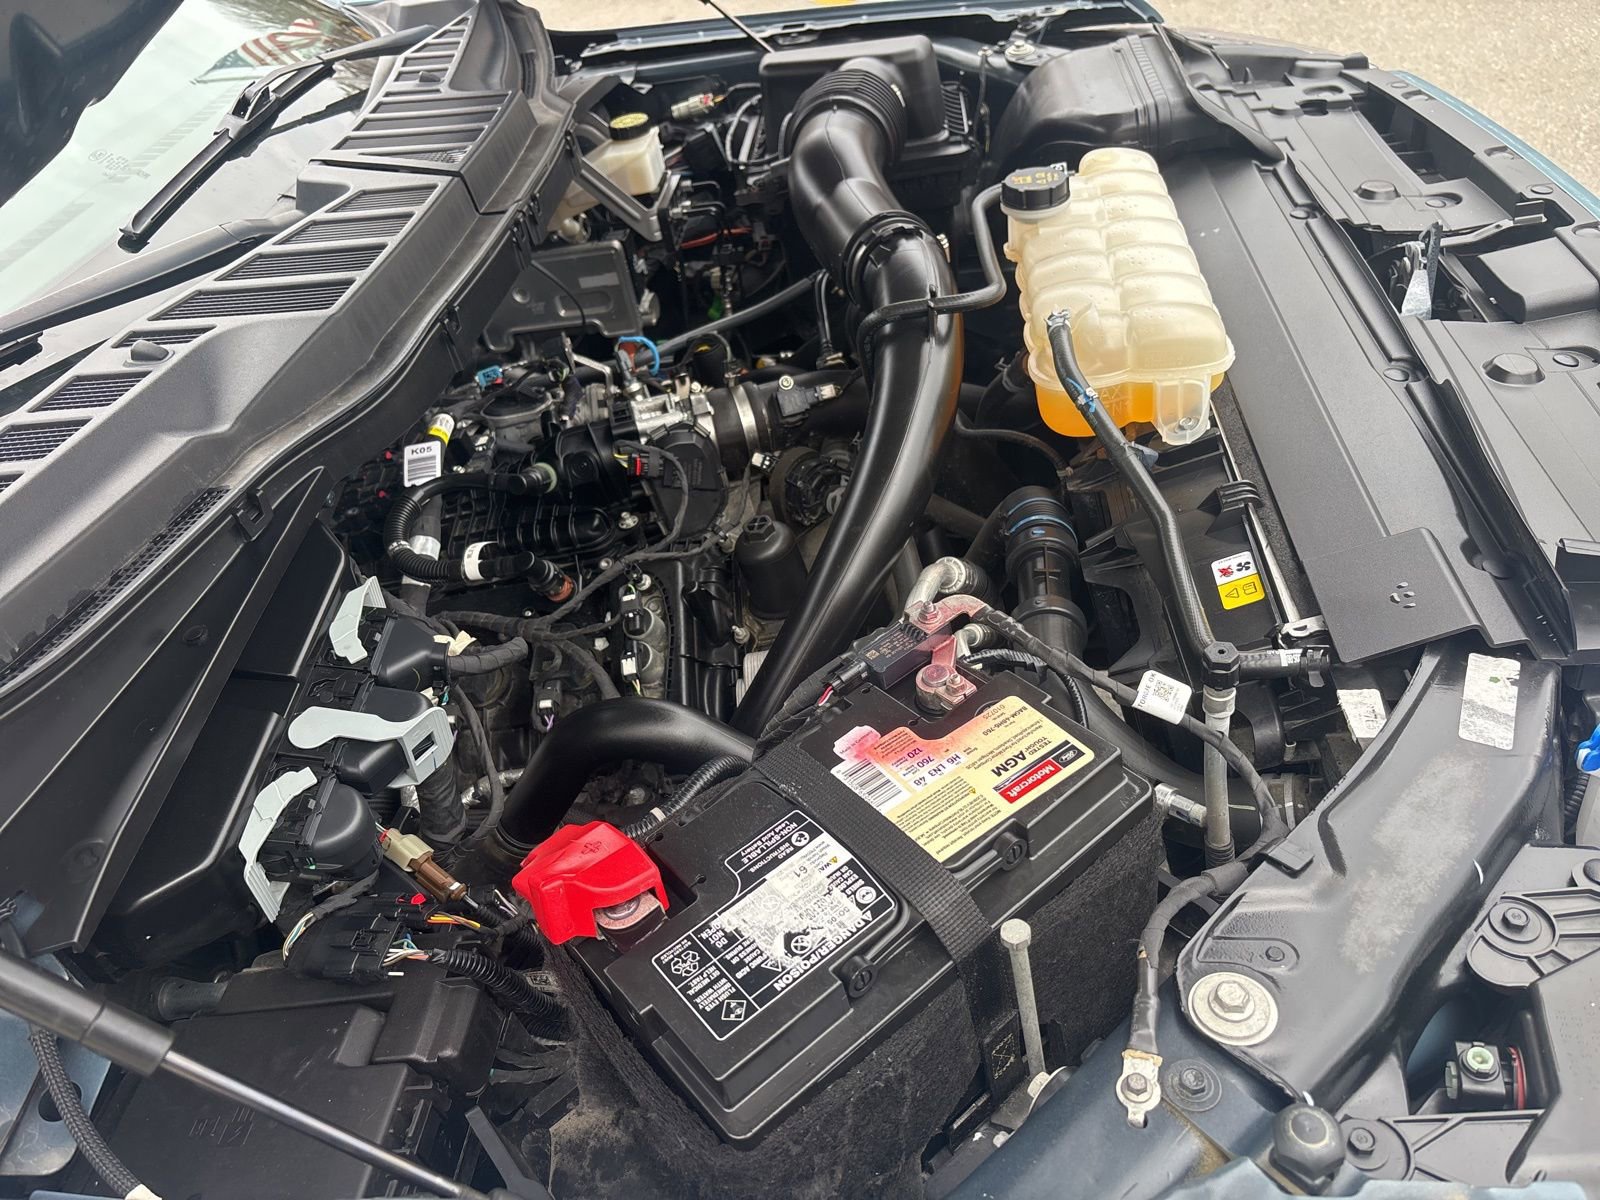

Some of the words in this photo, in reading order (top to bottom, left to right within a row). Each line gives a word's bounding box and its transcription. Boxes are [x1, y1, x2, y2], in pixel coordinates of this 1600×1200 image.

[411, 446, 433, 456] K05
[982, 705, 1005, 720] 010725
[907, 748, 922, 758] 120
[1029, 740, 1051, 755] TESTED
[917, 756, 934, 767] 760
[947, 754, 961, 764] H6
[1061, 751, 1076, 761] Ford
[928, 764, 946, 776] LN3
[991, 750, 1027, 777] AGM
[914, 776, 926, 785] 48
[1007, 765, 1055, 797] Motorcraft
[775, 821, 789, 832] Lead
[762, 831, 774, 842] Acid
[741, 822, 798, 865] NON-SPILLABLE
[741, 840, 762, 858] Battery
[748, 842, 790, 872] INSTRUCTIONS.
[778, 846, 794, 859] READ
[842, 870, 853, 879] CAN
[845, 879, 864, 895] SHIELD
[698, 921, 722, 939] OPEN.
[709, 930, 724, 944] NOT
[715, 937, 728, 948] DO
[724, 945, 743, 960] BURNS.
[744, 949, 760, 963] CAUSE
[773, 917, 865, 991] DANGER/POISON
[731, 956, 739, 964] OR
[703, 966, 716, 977] HELP
[710, 970, 720, 980] GET
[736, 966, 750, 979] ACID
[687, 978, 710, 995] MEDICAL
[688, 975, 703, 987] FAST.
[713, 978, 727, 990] WITH
[693, 988, 714, 1003] WATER.
[699, 982, 731, 1009] IMMEDIATELY
[718, 987, 736, 1001] FLUSH
[705, 999, 719, 1011] EYES
